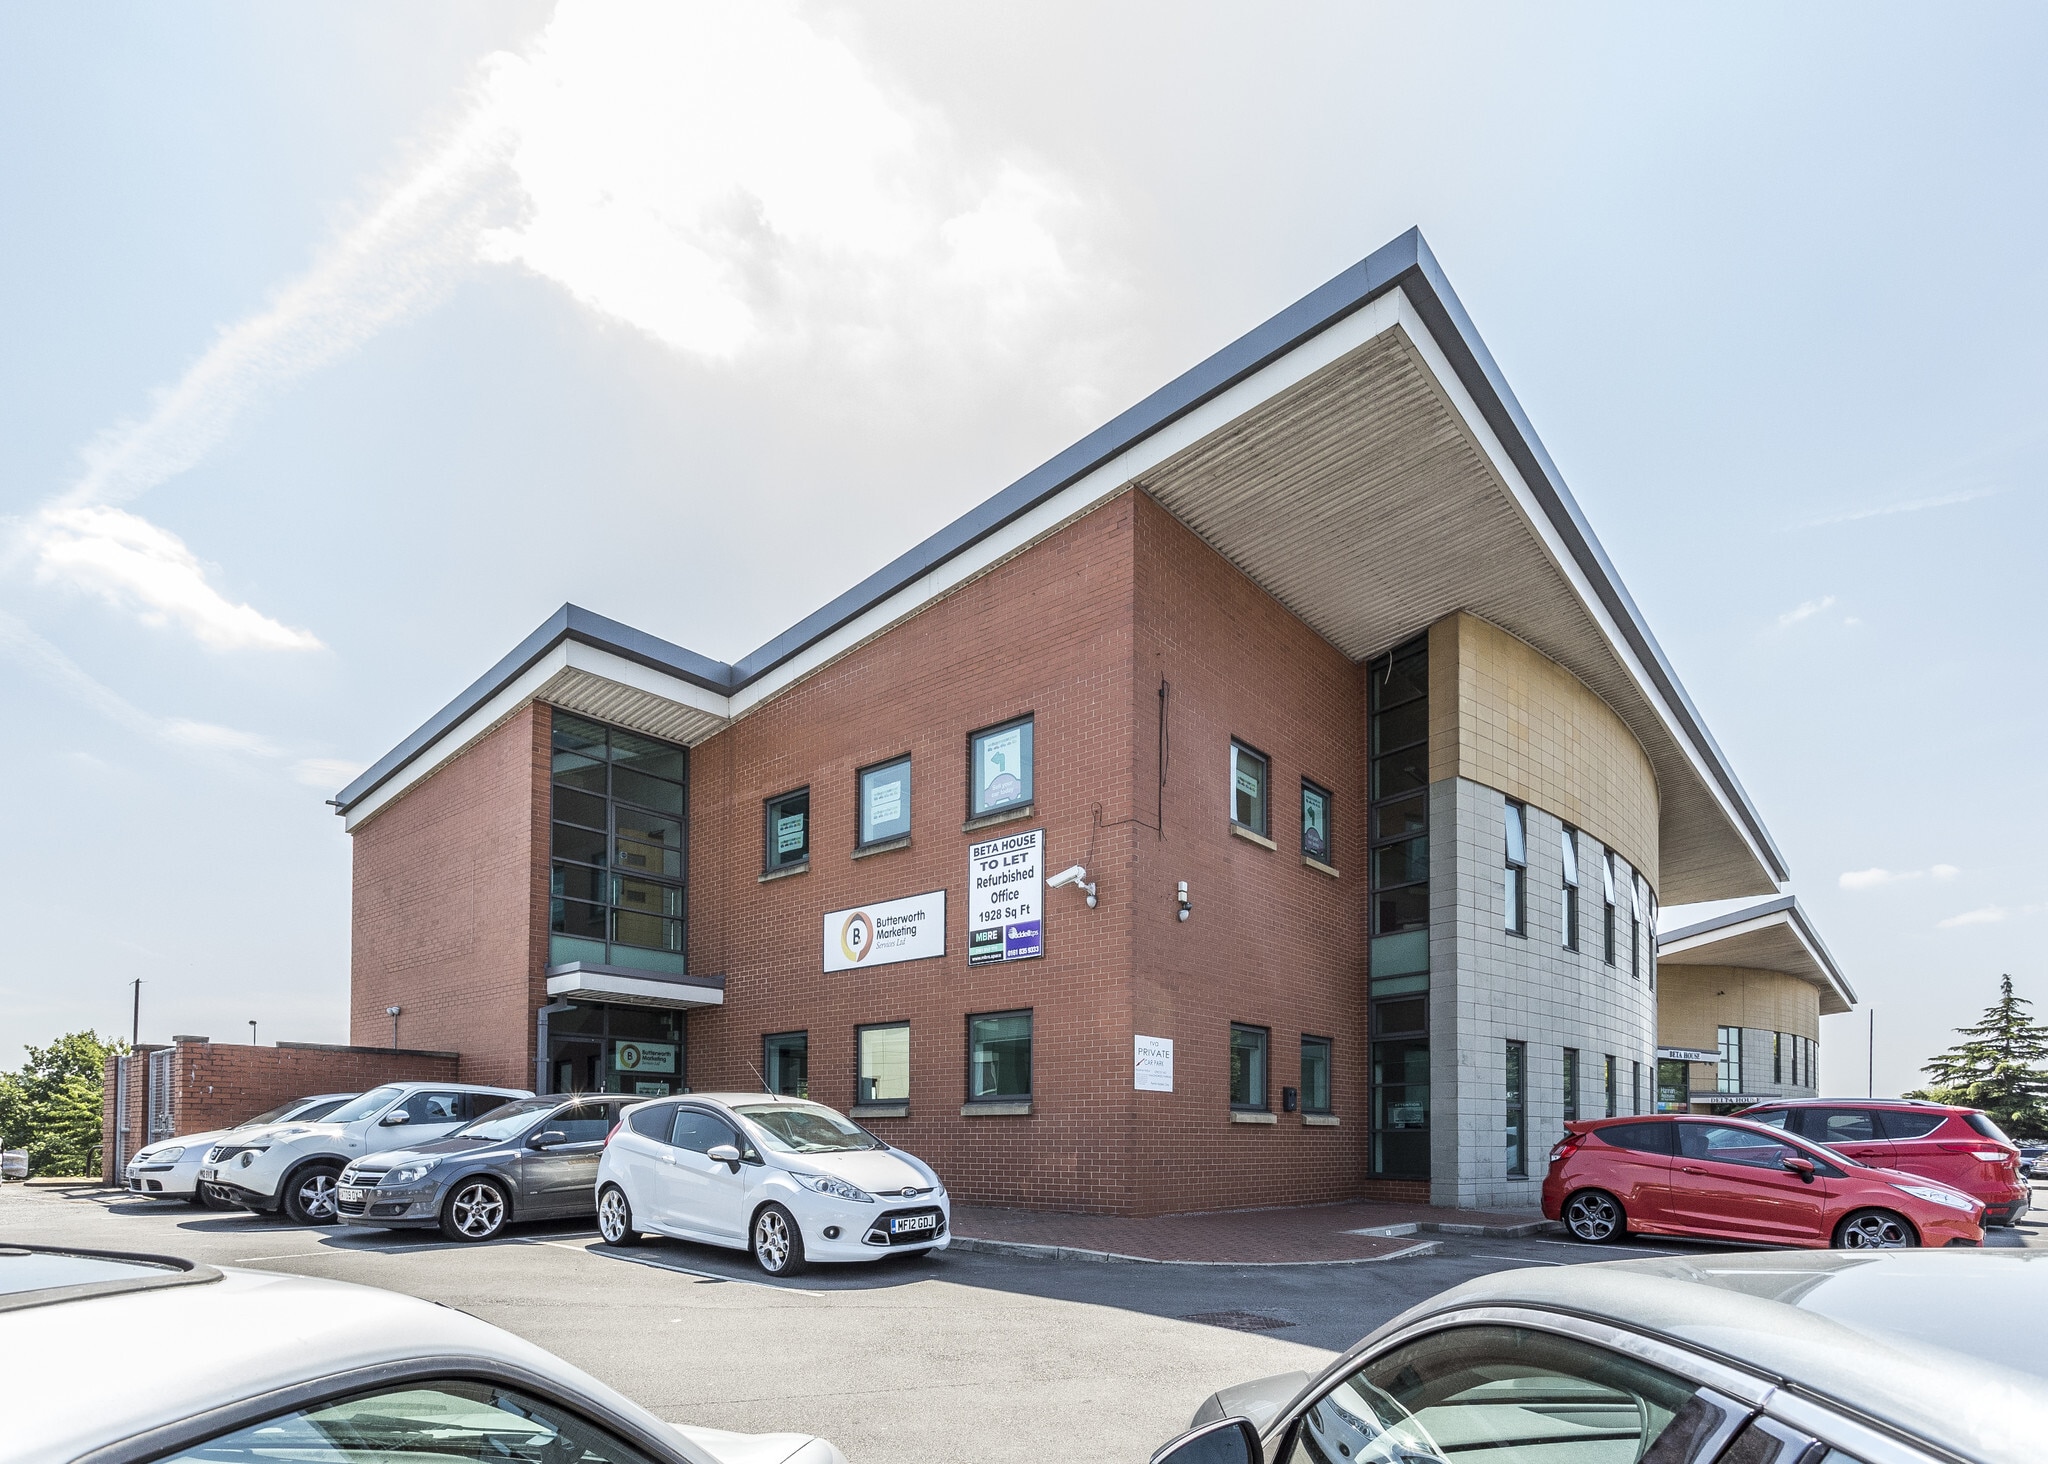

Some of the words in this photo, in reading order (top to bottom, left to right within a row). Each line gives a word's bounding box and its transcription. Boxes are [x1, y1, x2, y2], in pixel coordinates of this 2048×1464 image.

[974, 843, 999, 857] BETA
[1002, 834, 1036, 851] HOUSE
[980, 859, 999, 871] TO
[1003, 852, 1029, 867] LET
[976, 865, 1034, 889] Refurbished
[991, 888, 1019, 904] Office
[876, 909, 926, 928] Butterworth
[979, 908, 1002, 922] 1928
[1005, 907, 1017, 919] Sq
[1020, 904, 1030, 915] Ft
[853, 927, 861, 945] B
[876, 925, 917, 940] Marketing
[975, 930, 998, 943] MBRE
[875, 939, 896, 950] Services
[896, 938, 906, 947] Ltd
[627, 1051, 633, 1061] B
[1137, 1047, 1170, 1059] PRIVATE
[897, 1219, 916, 1231] MF12
[918, 1216, 934, 1229] GDJ
